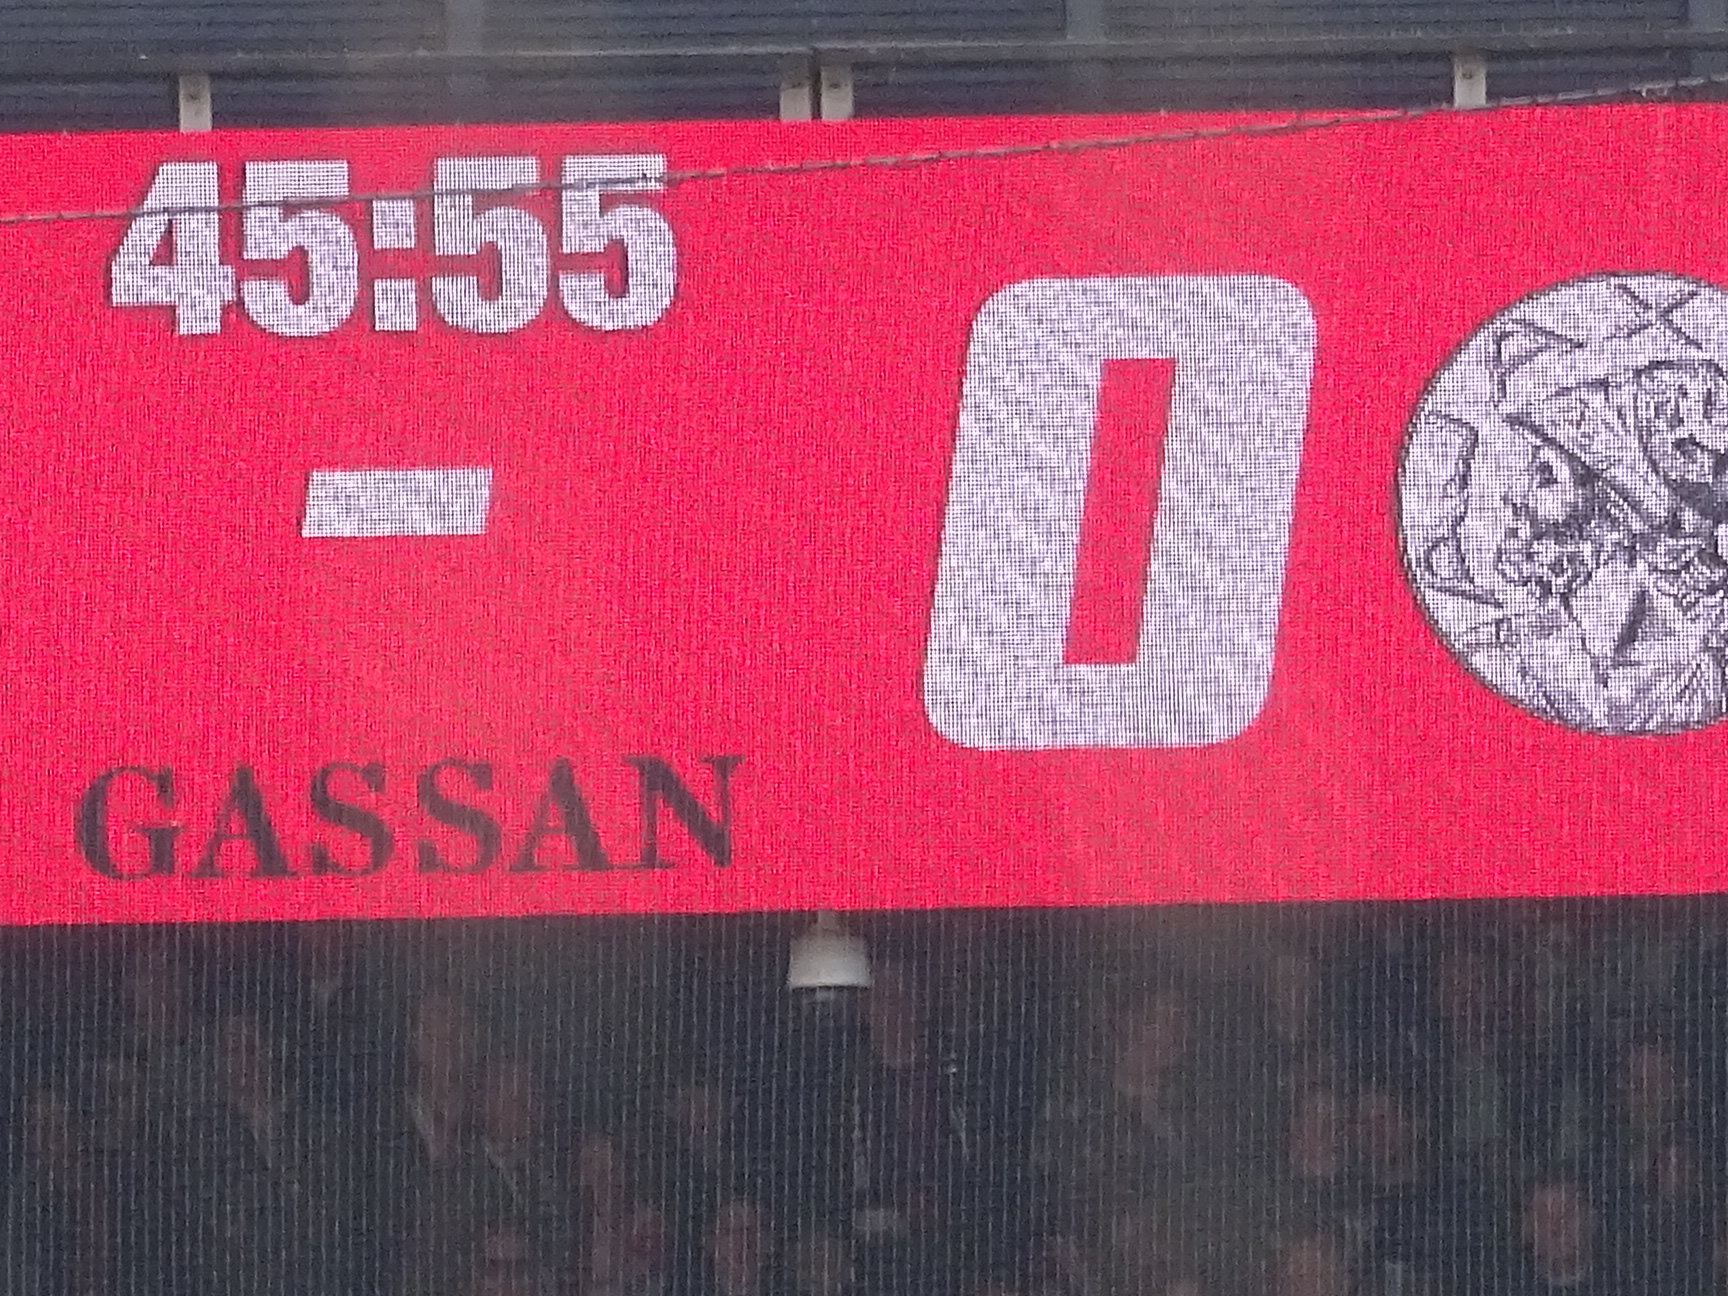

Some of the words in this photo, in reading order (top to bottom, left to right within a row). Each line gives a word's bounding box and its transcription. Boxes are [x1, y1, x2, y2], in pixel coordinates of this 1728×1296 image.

[110, 153, 678, 337] 45:55
[923, 273, 1318, 752] 0
[78, 754, 744, 881] GASSAN
